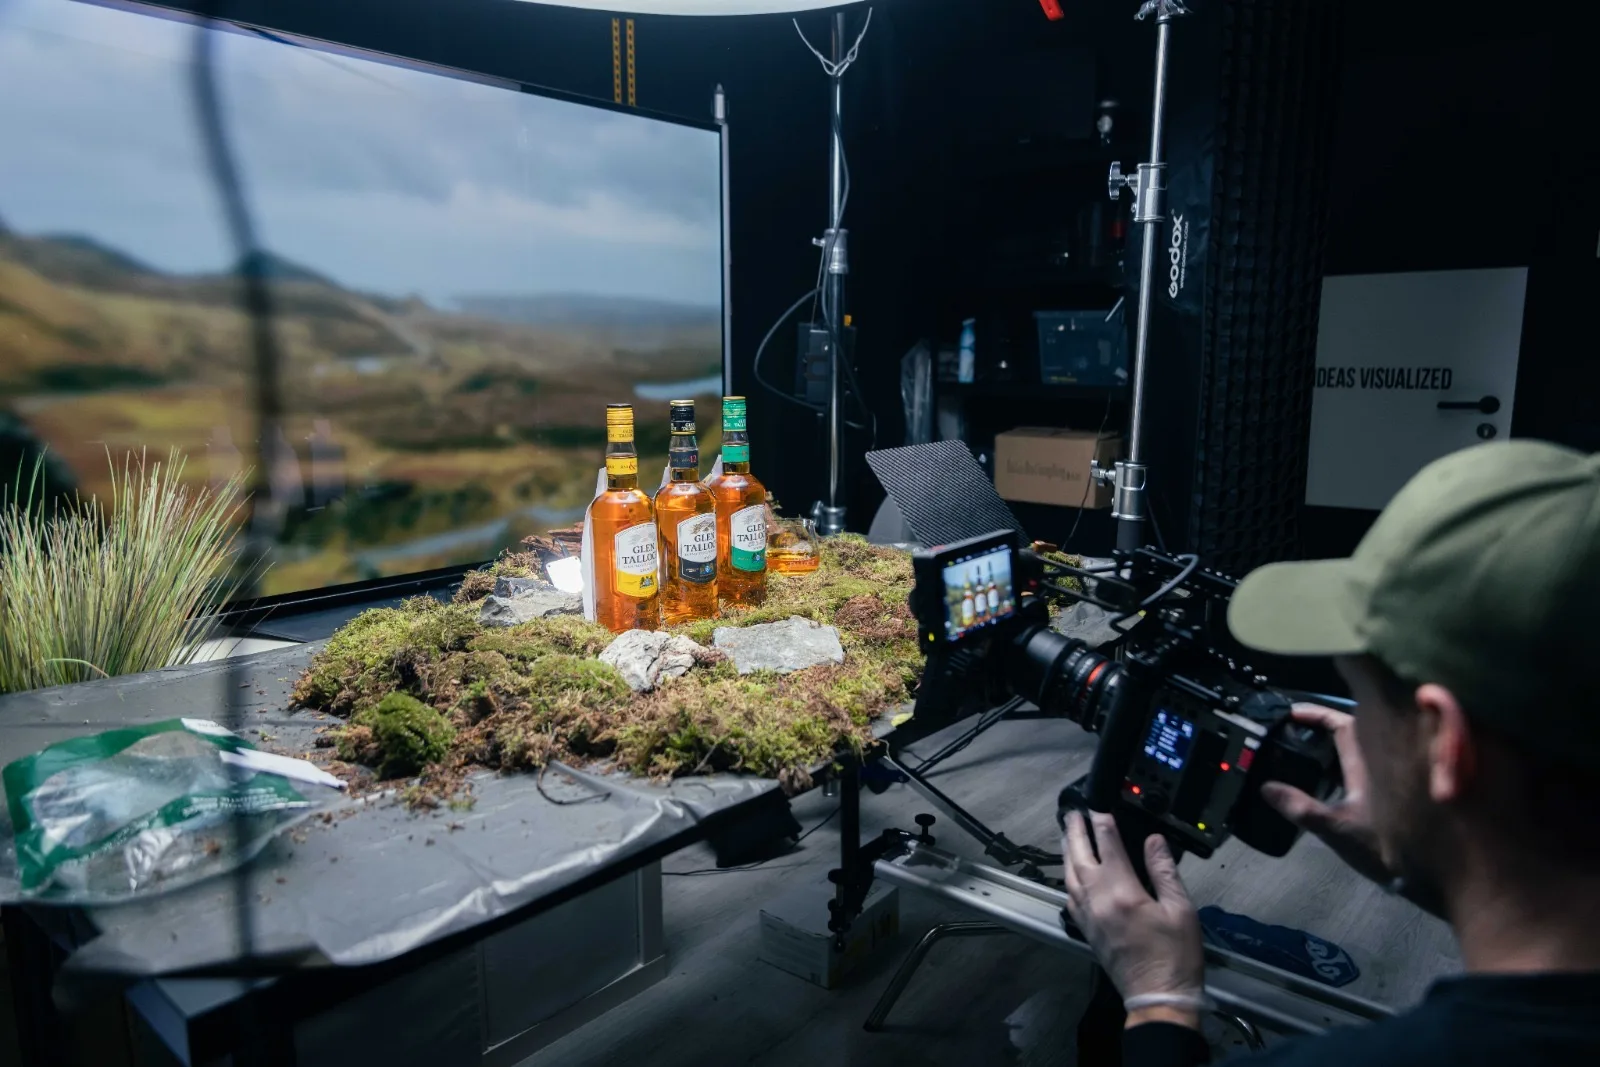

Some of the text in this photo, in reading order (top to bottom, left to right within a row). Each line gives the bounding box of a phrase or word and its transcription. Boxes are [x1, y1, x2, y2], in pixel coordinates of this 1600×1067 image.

[1360, 367, 1453, 390] VISUALIZED
[693, 531, 715, 543] GLEN
[632, 542, 655, 554] GLEN
